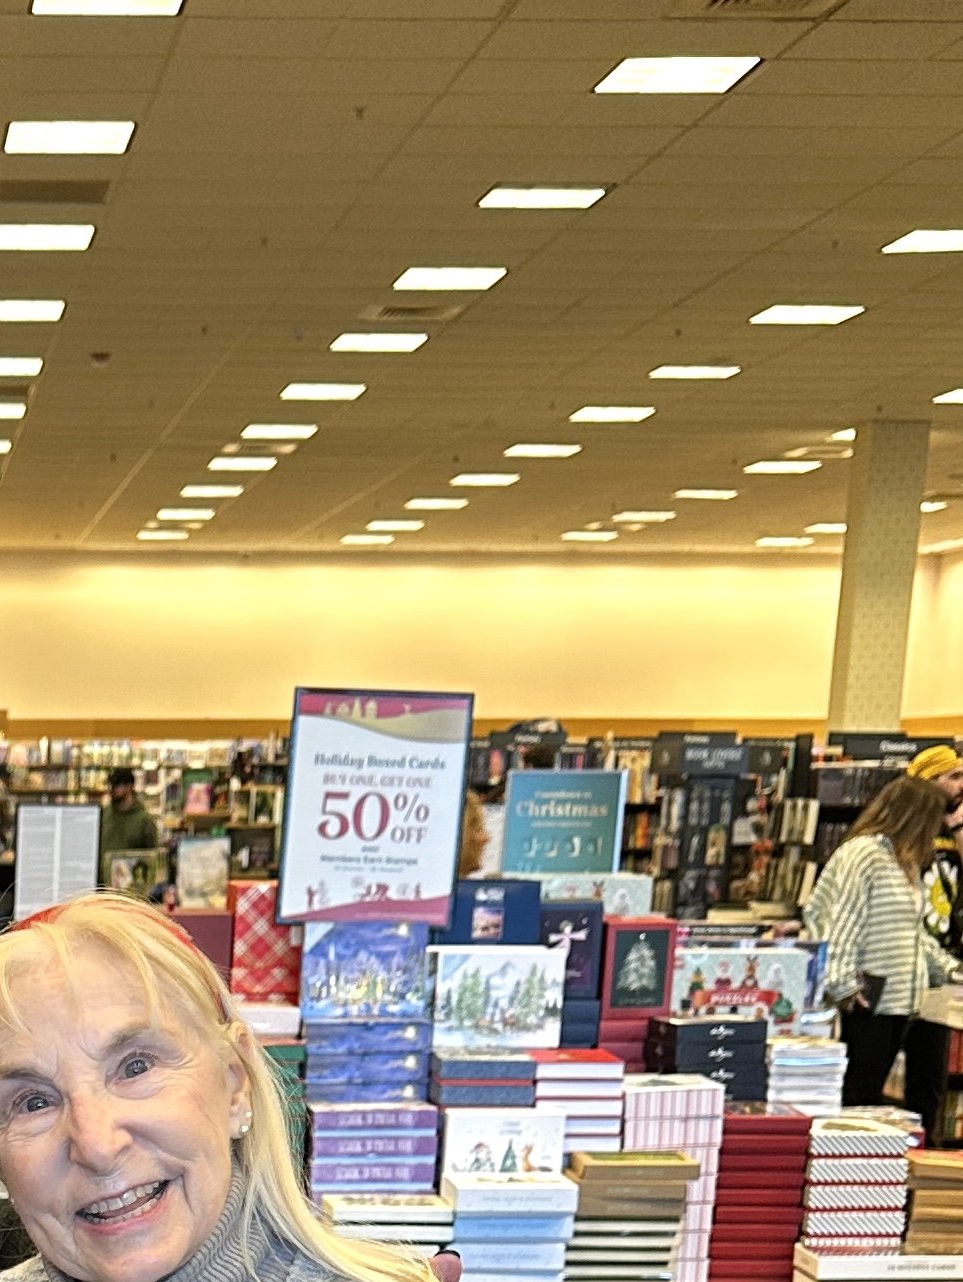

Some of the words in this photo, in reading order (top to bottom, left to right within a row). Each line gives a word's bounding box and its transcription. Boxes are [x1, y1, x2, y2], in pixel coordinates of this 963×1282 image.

[314, 754, 364, 769] Holiday
[366, 754, 406, 769] Boxed
[408, 756, 446, 769] Cards
[323, 774, 348, 786] BUY
[379, 775, 405, 788] GET
[406, 776, 432, 788] ONE
[317, 790, 430, 842] 50%
[515, 801, 609, 818] Christmas
[390, 826, 427, 844] OFF
